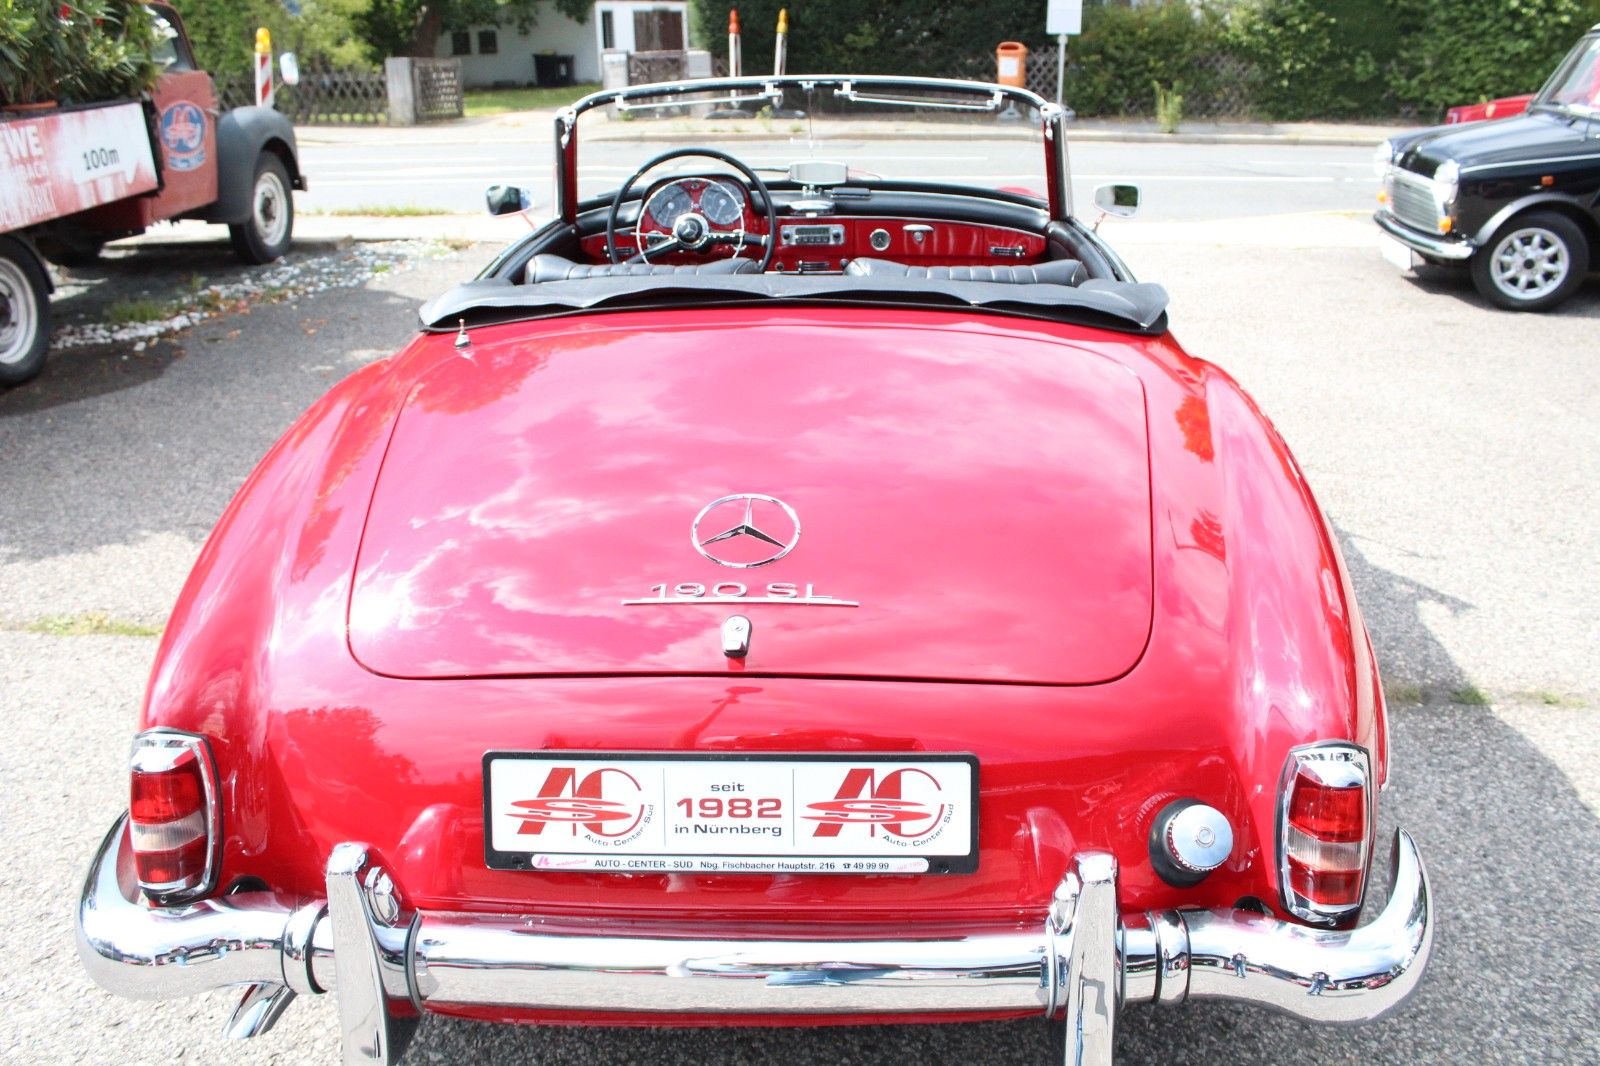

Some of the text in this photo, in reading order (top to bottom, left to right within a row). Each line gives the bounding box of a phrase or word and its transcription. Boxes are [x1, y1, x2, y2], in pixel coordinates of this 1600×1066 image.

[82, 147, 121, 171] 100m
[650, 582, 833, 600] 190 SL
[710, 781, 745, 792] seit
[676, 797, 783, 819] 1982
[674, 823, 782, 837] in Nürnberg
[594, 859, 620, 868] AUTO
[627, 860, 666, 868] CENTER
[722, 861, 775, 870] Fischbacher
[777, 861, 817, 871] Hauptstr.
[819, 862, 835, 870] 216
[853, 862, 864, 870] 49
